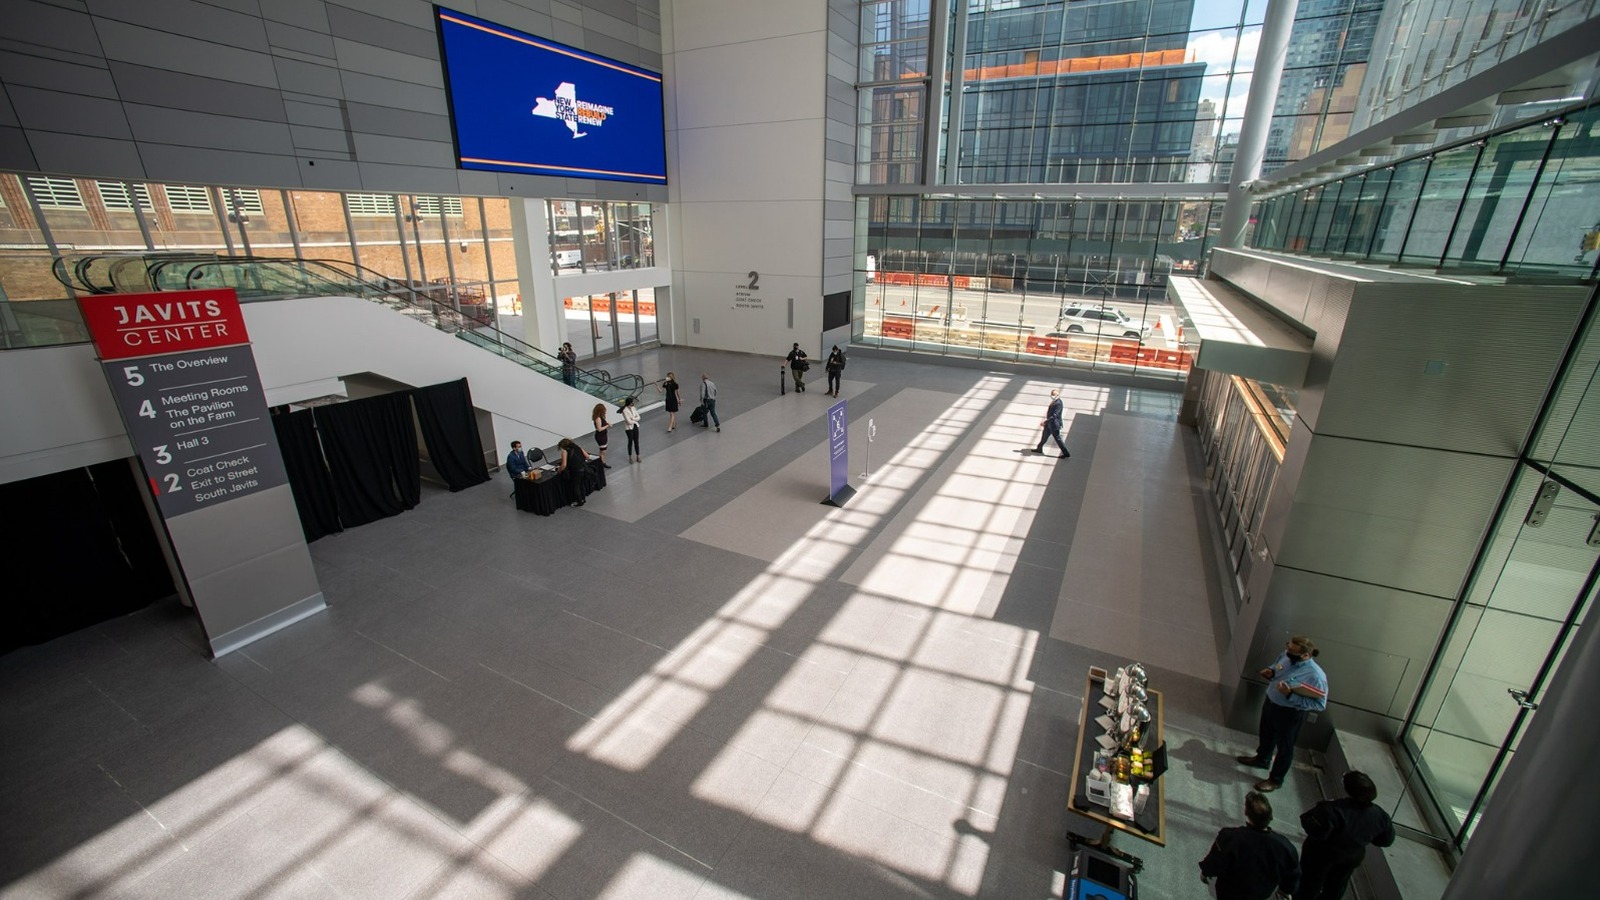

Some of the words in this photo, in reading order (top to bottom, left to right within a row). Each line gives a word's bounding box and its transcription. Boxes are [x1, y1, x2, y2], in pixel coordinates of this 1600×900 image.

[556, 97, 571, 106] NEW
[556, 104, 575, 114] YORK
[577, 100, 614, 115] REIMAGINE
[555, 111, 578, 122] STATE
[577, 107, 607, 120] REBUILD
[577, 116, 602, 126] RENEW
[748, 270, 760, 290] 2
[114, 300, 221, 325] JAVITS
[123, 323, 229, 346] CENTER
[123, 366, 145, 387] 5
[149, 362, 174, 373] The
[177, 356, 229, 369] Overview
[161, 391, 209, 406] Meeting
[211, 384, 249, 397] Rooms
[138, 400, 157, 419] 4
[165, 408, 189, 419] The
[191, 400, 234, 414] Pavilion
[170, 420, 186, 429] on
[188, 415, 206, 425] the
[207, 409, 236, 421] Farm
[152, 444, 173, 465] 3
[176, 438, 200, 451] Hall
[201, 436, 210, 445] 3
[186, 464, 214, 477] Coat
[216, 456, 250, 470] Check
[163, 473, 183, 493] 2
[191, 478, 213, 490] Exit
[214, 475, 226, 484] to
[227, 466, 259, 480] Street
[195, 487, 228, 502] South
[229, 479, 259, 493] Javits
